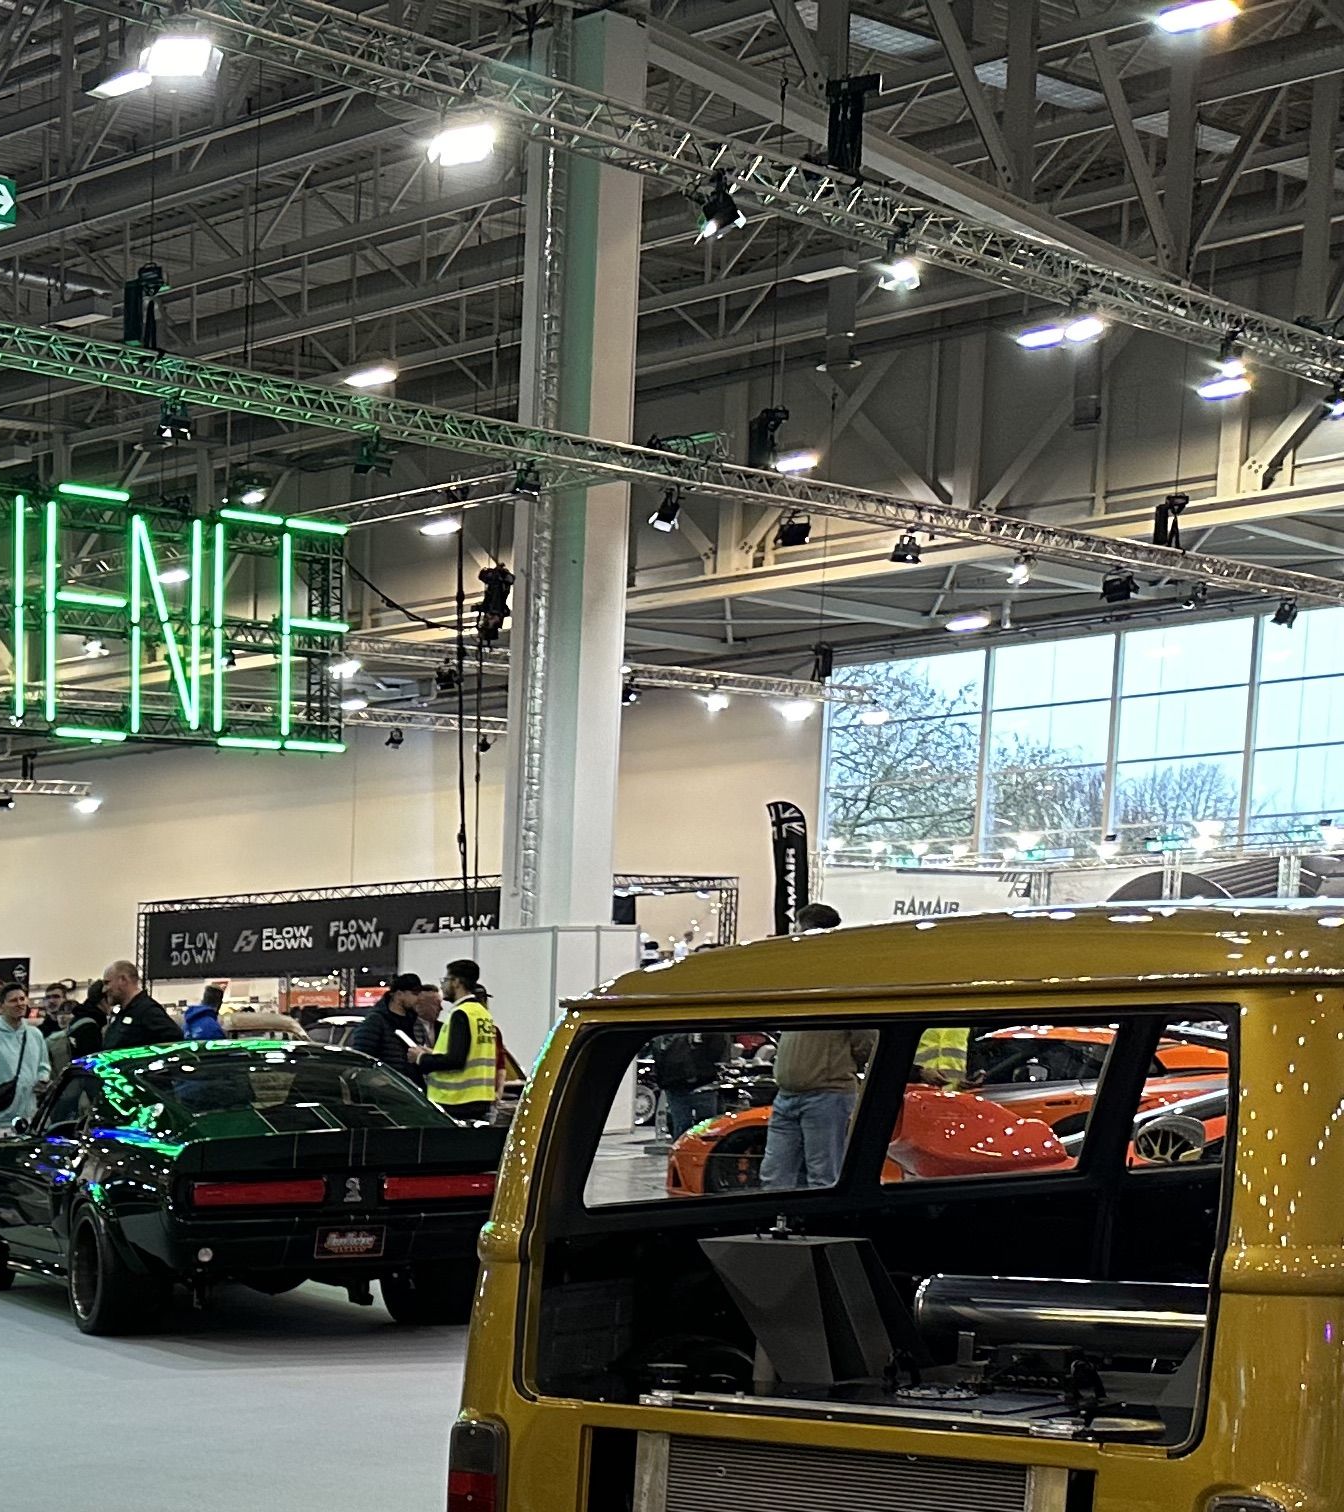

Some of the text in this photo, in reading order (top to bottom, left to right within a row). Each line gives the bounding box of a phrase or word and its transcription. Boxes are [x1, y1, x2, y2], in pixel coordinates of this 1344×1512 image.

[894, 896, 959, 916] RAMAIR
[262, 926, 310, 939] FLOW
[329, 917, 378, 937] FLOW
[170, 932, 218, 949] FLOW
[262, 937, 312, 951] DOWN
[337, 931, 384, 953] DOWN
[170, 949, 216, 966] DOWN
